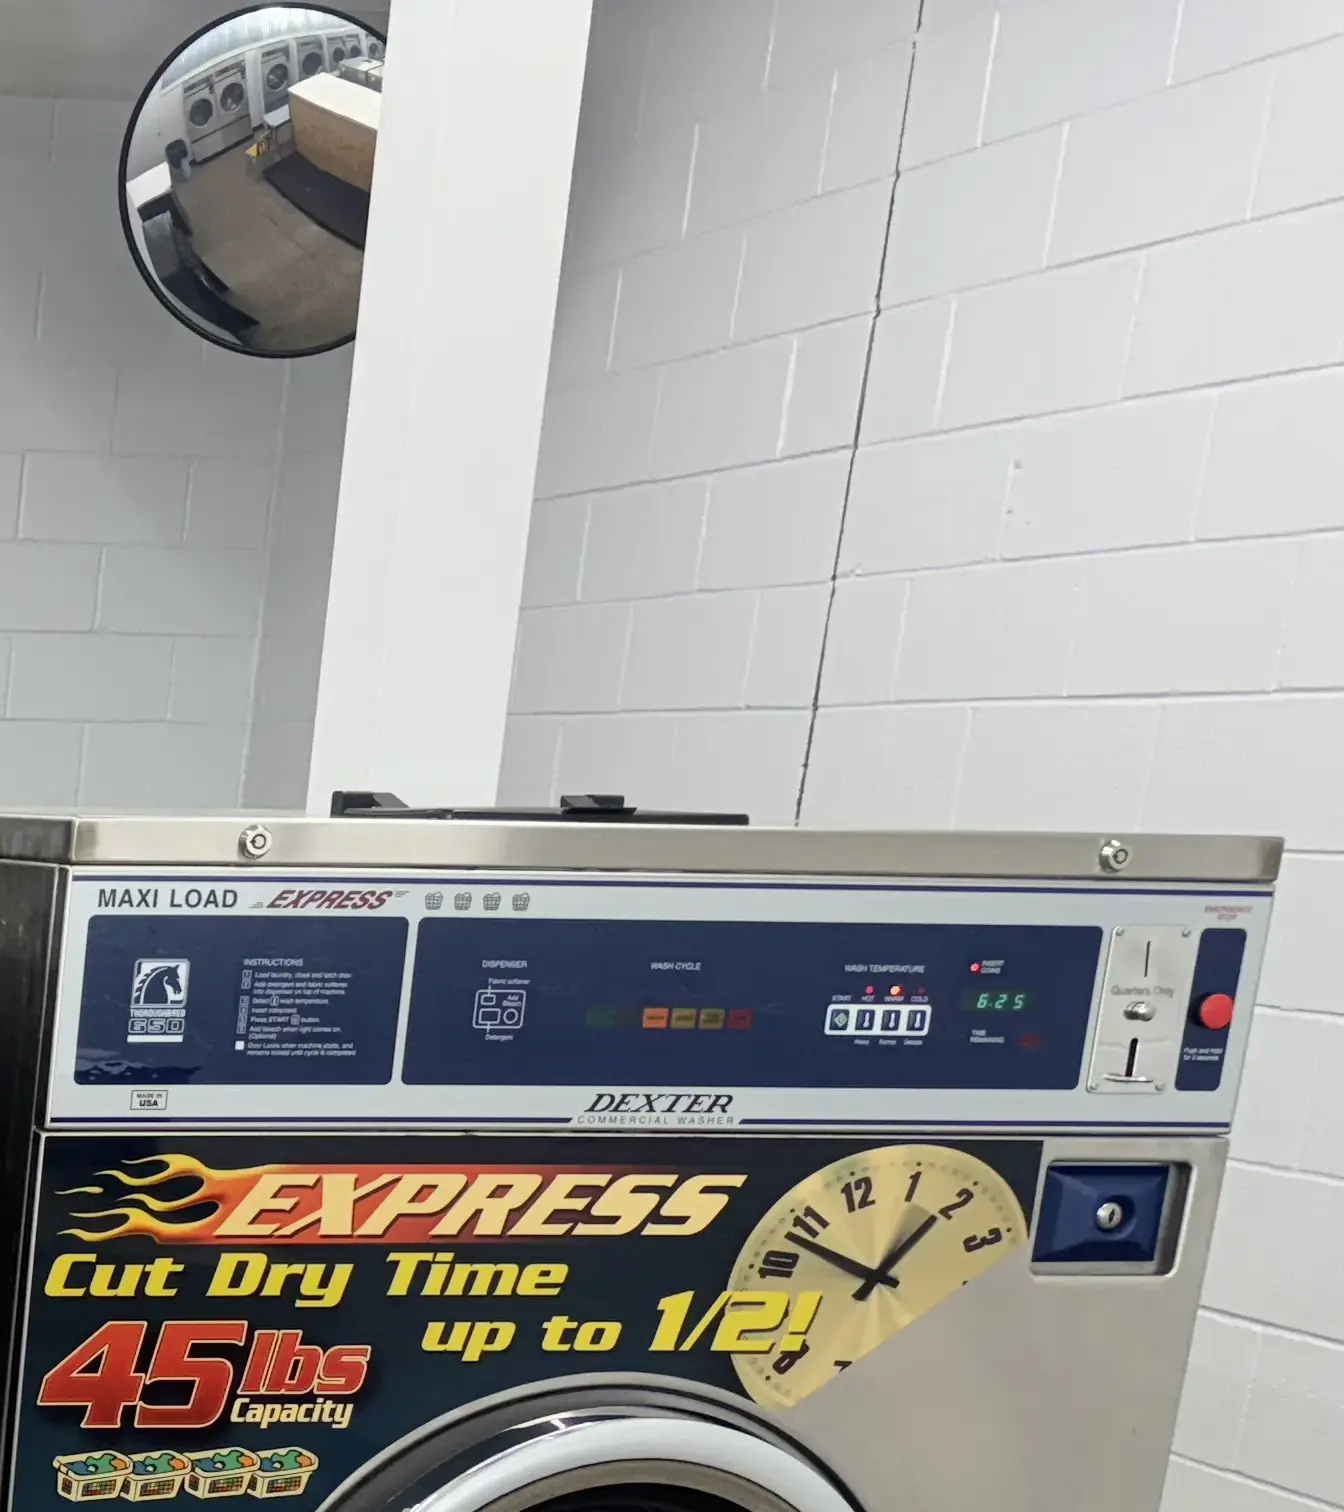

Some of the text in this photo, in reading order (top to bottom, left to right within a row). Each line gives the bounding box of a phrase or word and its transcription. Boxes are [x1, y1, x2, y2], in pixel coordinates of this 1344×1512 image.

[98, 888, 238, 909] MAXI LOAD
[267, 889, 396, 909] EXPRESS
[244, 958, 303, 966] INSTRUCTIONS
[482, 960, 527, 968] DISPENSER
[650, 961, 701, 971] WASH CYCLE
[869, 964, 925, 973] TEMPERATURE
[1154, 986, 1175, 998] Only
[583, 1093, 734, 1114] DEXTER
[577, 1113, 735, 1125] COMMERCIAL WASHER
[840, 1175, 876, 1214] 12
[903, 1171, 922, 1203] 1
[214, 1172, 747, 1238] EXPRESS
[937, 1189, 974, 1221] 2
[792, 1206, 830, 1240] 11
[962, 1226, 1003, 1253] 3
[758, 1250, 801, 1280] 10
[44, 1252, 569, 1308] Cut Dry Time
[420, 1289, 824, 1361] up to 1/2!
[37, 1320, 373, 1429] 45 lbs
[230, 1398, 353, 1429] Capacity
